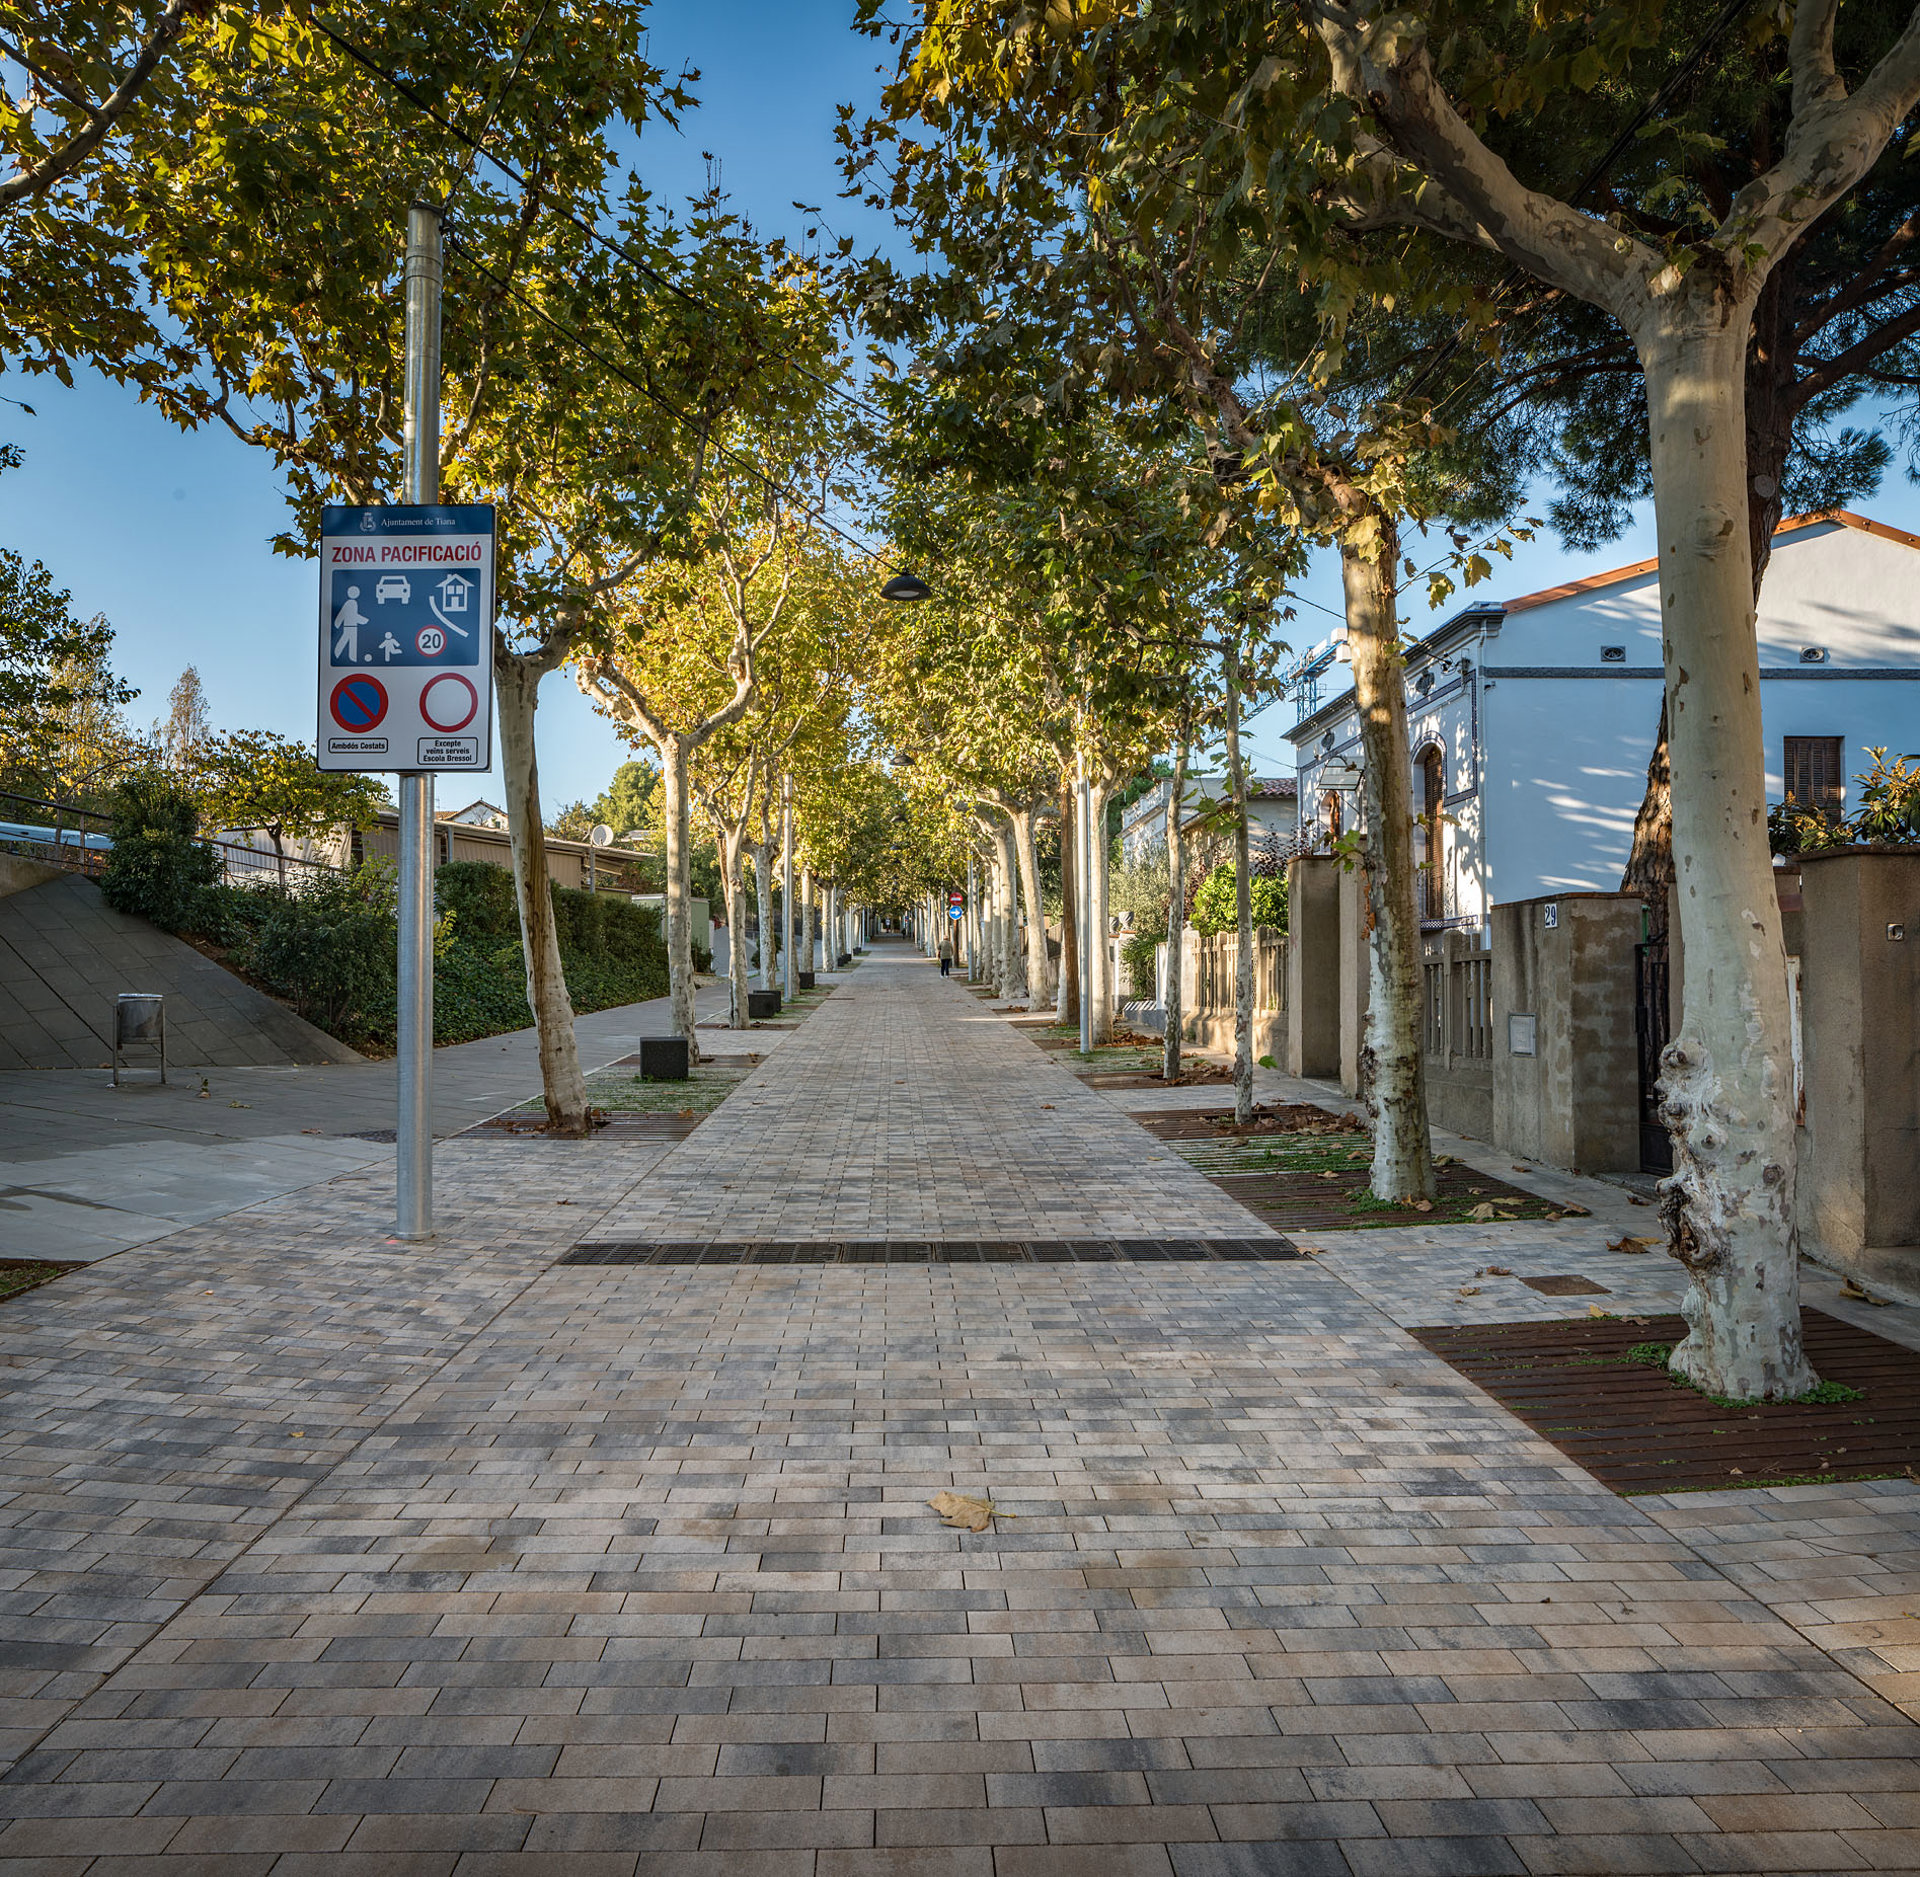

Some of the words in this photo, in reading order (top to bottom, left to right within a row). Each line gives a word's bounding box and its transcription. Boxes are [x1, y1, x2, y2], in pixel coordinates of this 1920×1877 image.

[381, 518, 423, 528] Ajuntament
[424, 518, 434, 526] de
[436, 517, 456, 526] Tiana
[332, 547, 376, 562] ZONA
[381, 541, 482, 562] PACIFICACIÓ
[421, 633, 441, 649] 20
[1545, 905, 1556, 925] 29
